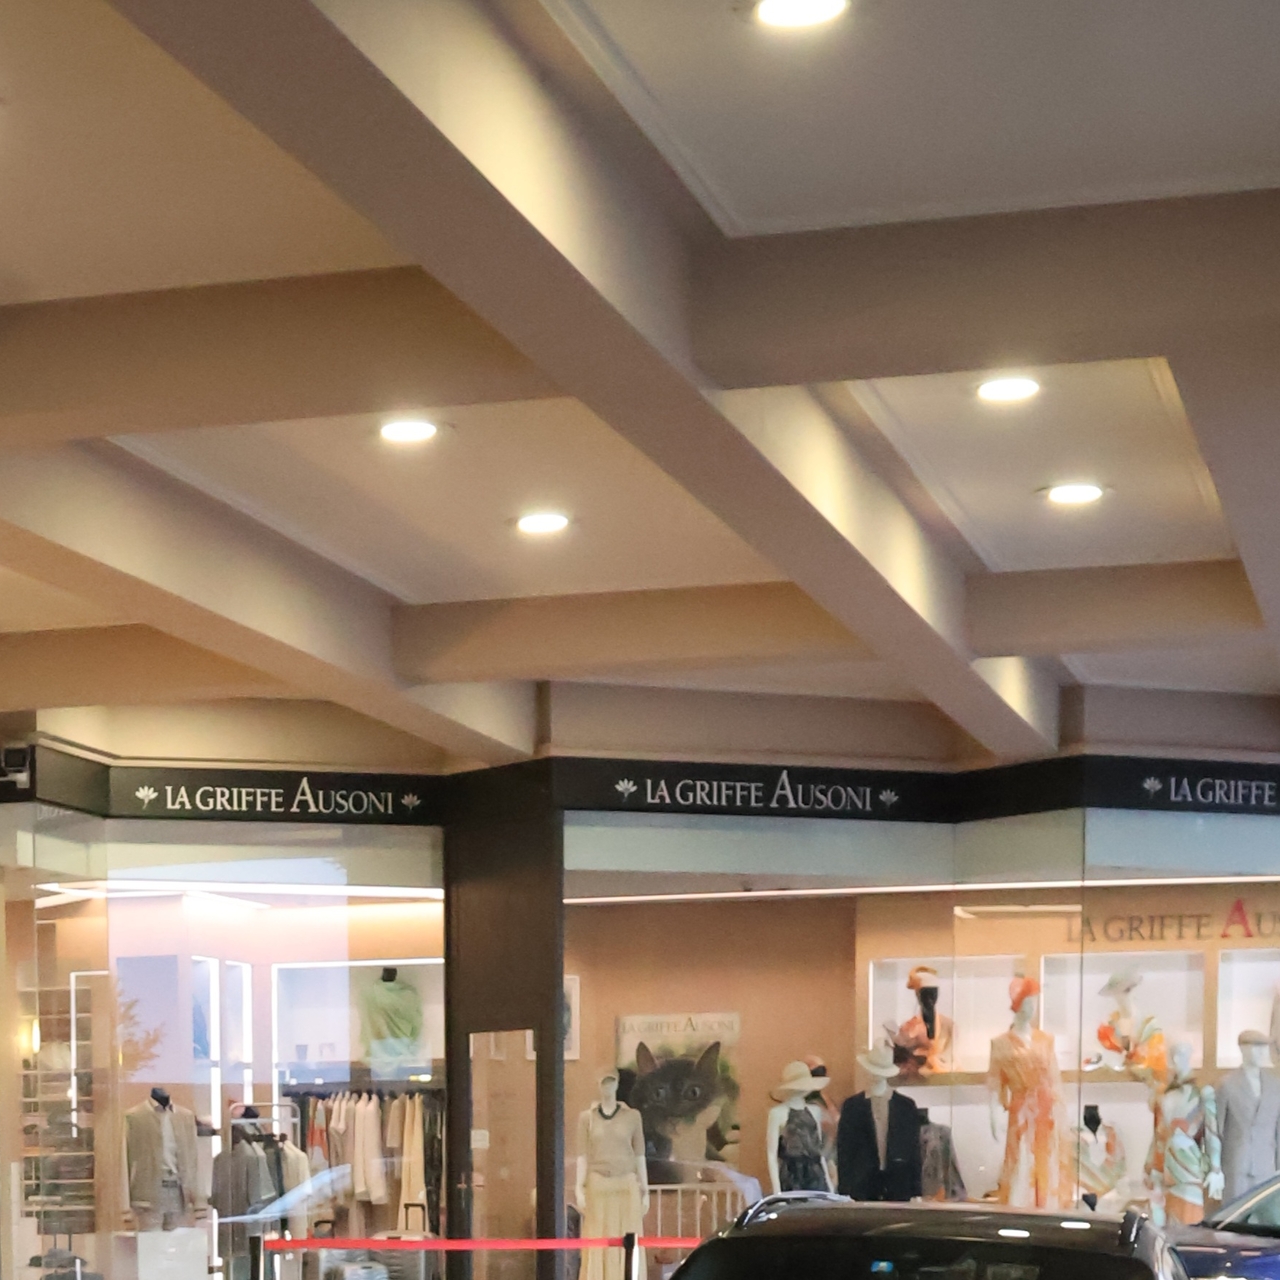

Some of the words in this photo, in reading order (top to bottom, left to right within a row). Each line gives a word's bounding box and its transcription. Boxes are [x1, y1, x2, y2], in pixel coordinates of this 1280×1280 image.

[165, 785, 192, 810] LA
[195, 786, 285, 813] GRIFFE
[289, 776, 394, 815] AUSONI
[646, 778, 671, 804] LA
[675, 779, 764, 807] GRIFFE
[770, 769, 872, 811] AUSONI
[1170, 777, 1193, 802] LA
[1196, 778, 1277, 806] GRIFFE
[1102, 914, 1212, 943] GRIFFE
[1220, 898, 1280, 939] AU
